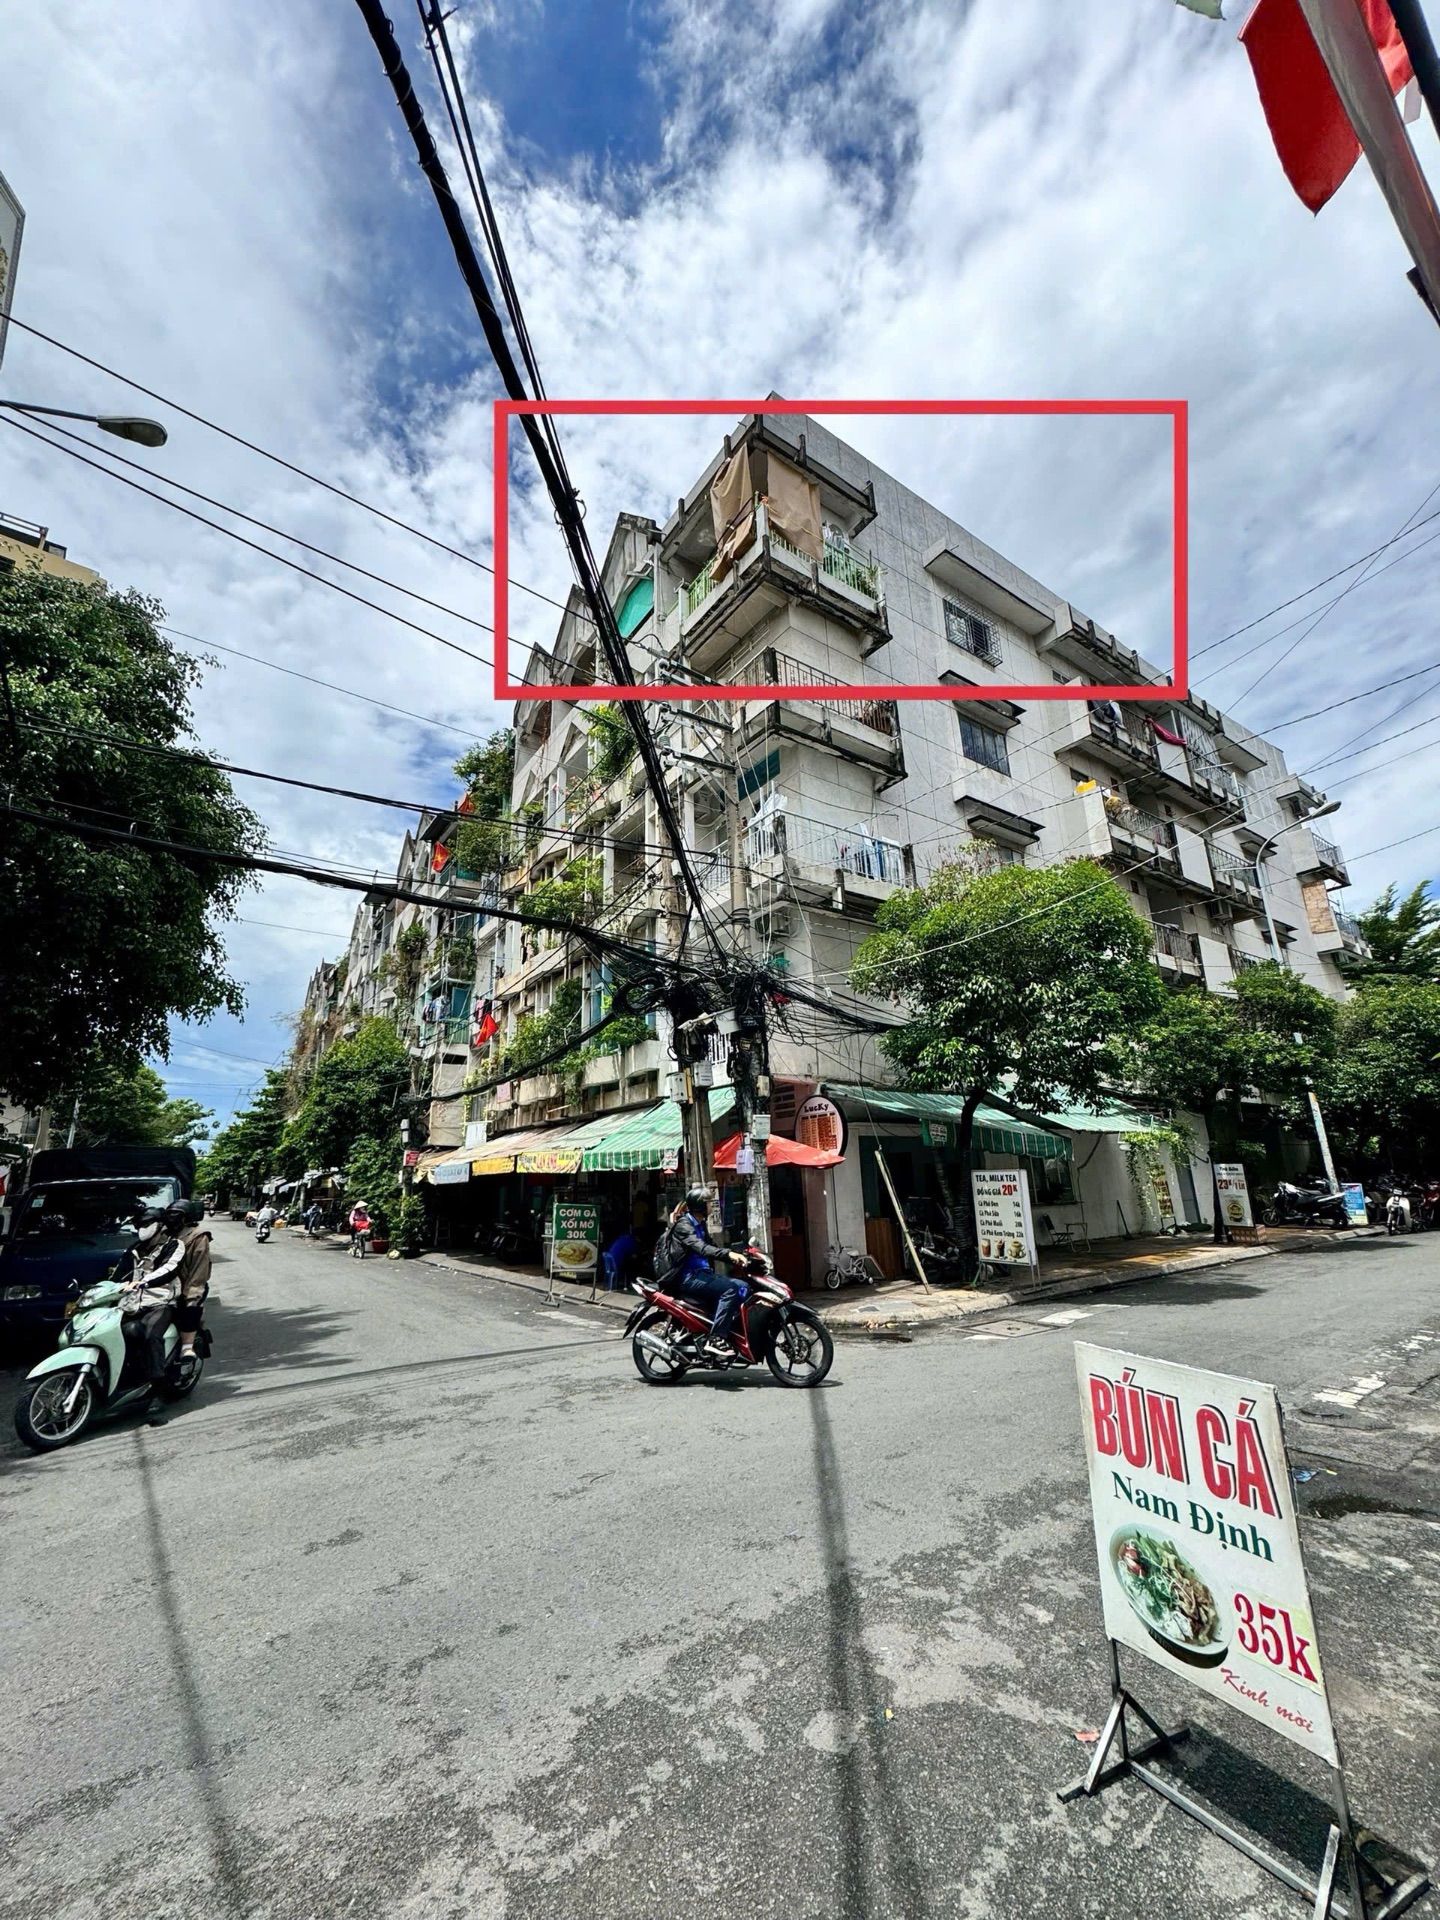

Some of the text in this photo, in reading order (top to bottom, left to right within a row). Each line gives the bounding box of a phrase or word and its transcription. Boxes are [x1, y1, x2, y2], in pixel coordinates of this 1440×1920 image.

[975, 1174, 1017, 1183] TEA, MILK TEA
[559, 1208, 597, 1218] CƠM GÀ
[566, 1230, 587, 1239] 30K
[1089, 1367, 1283, 1519] BÚN CÁ
[1111, 1470, 1274, 1562] Nam Định
[1234, 1593, 1318, 1684] 35k
[1277, 1709, 1314, 1734] mời
